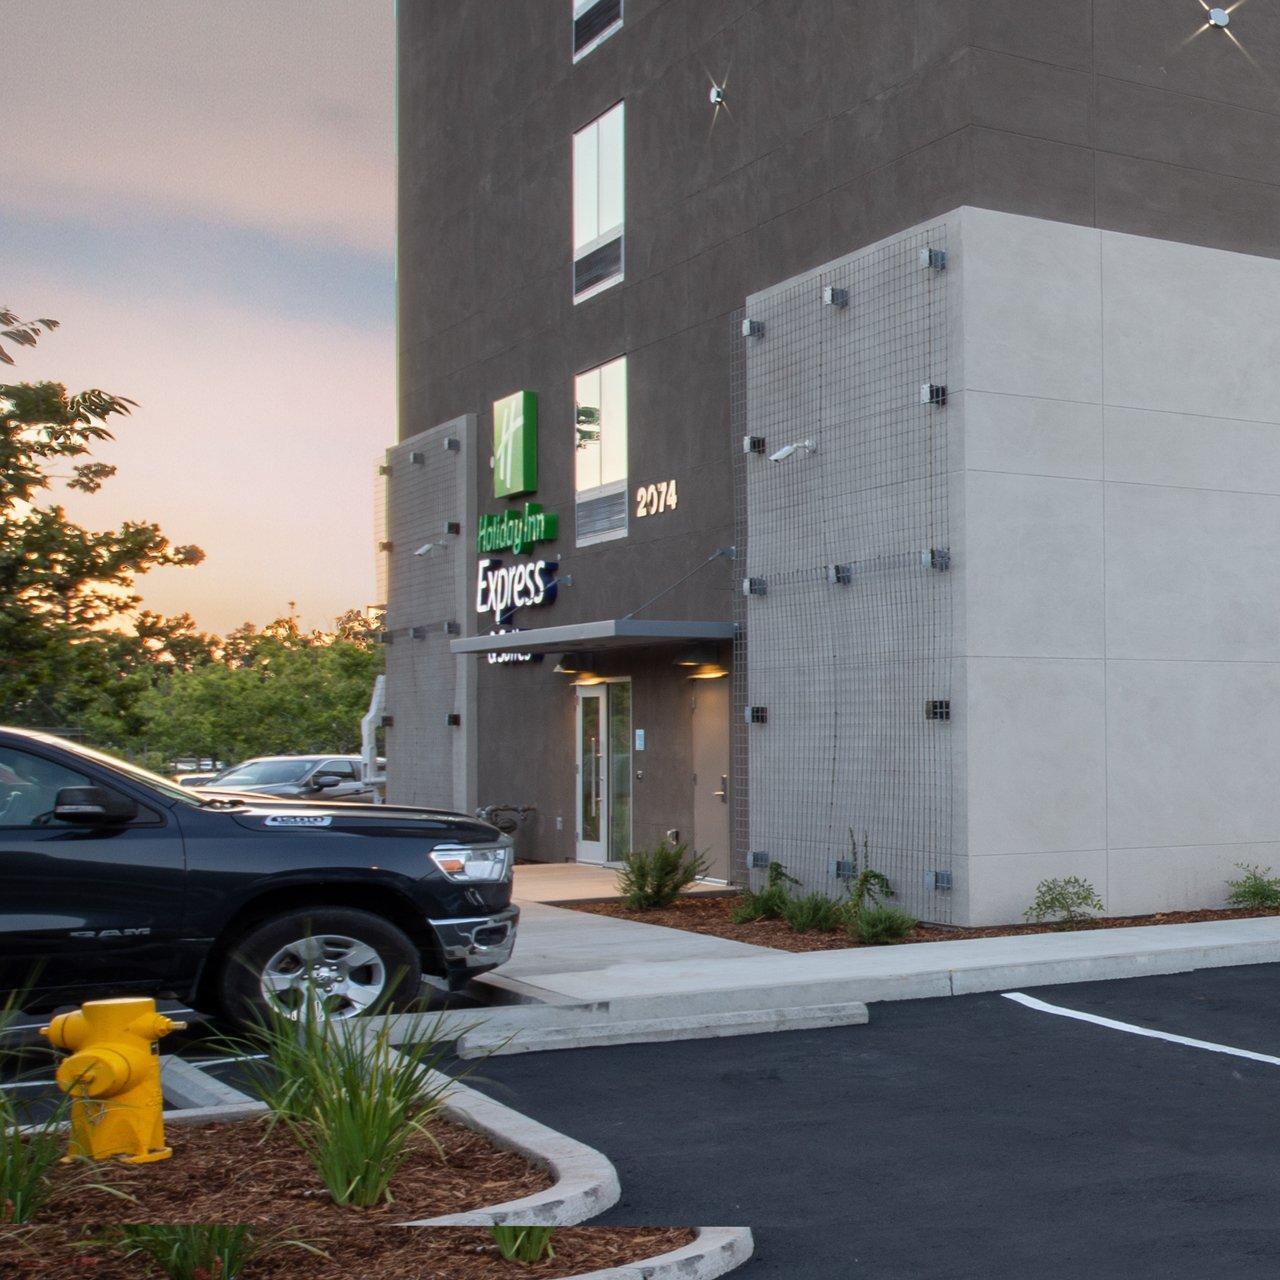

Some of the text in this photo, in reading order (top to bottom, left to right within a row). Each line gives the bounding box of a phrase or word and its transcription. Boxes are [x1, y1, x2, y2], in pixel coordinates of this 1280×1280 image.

[636, 479, 678, 518] 2074
[477, 502, 545, 555] Holiday Inn
[476, 558, 546, 625] Express
[69, 927, 152, 938] RAM
